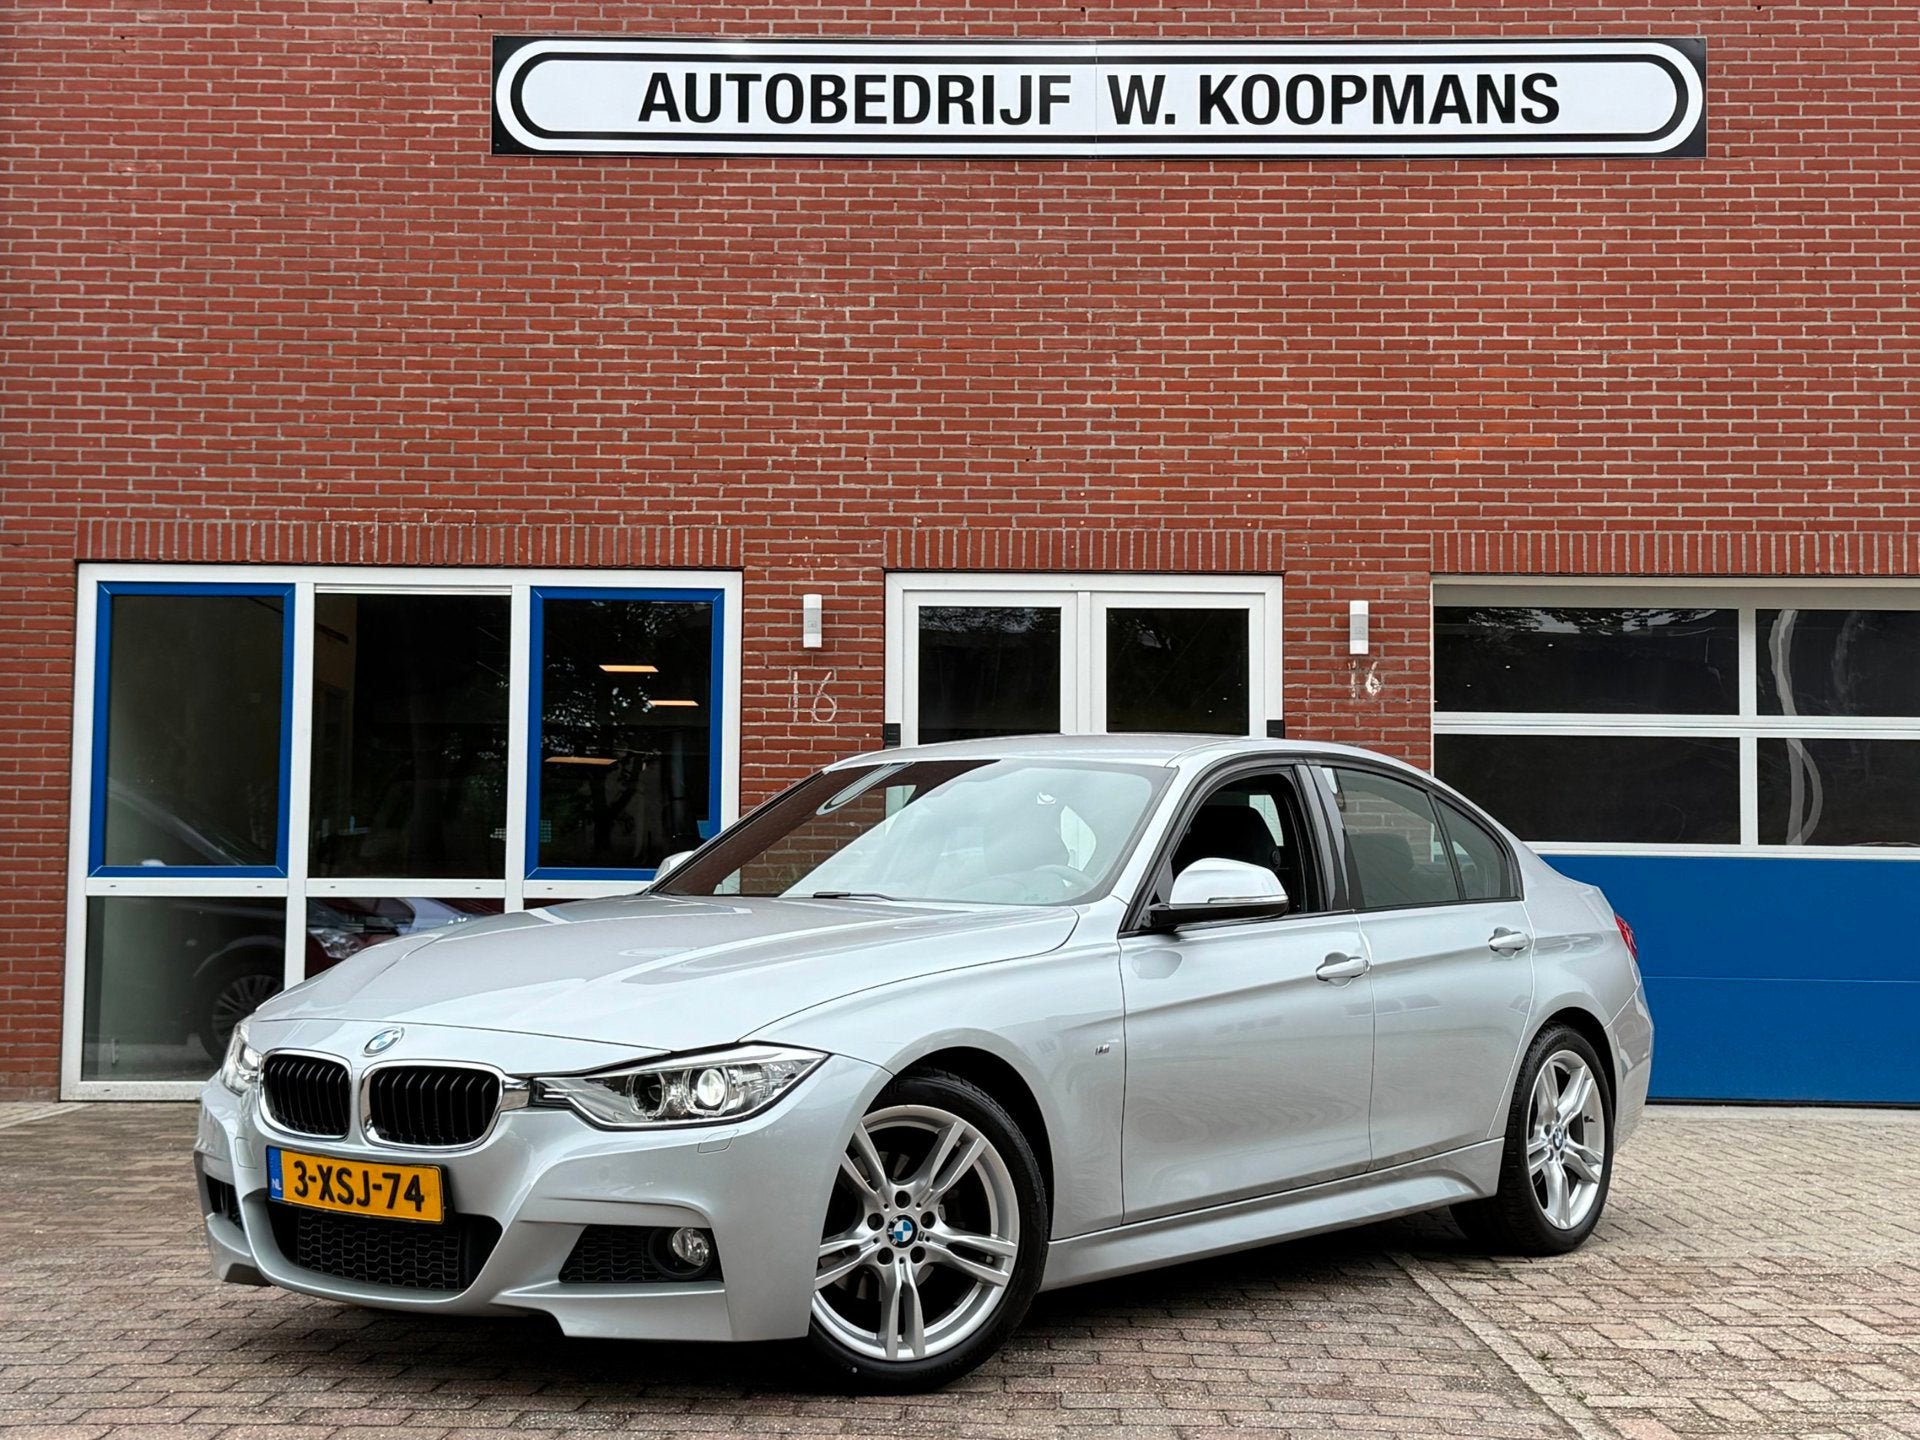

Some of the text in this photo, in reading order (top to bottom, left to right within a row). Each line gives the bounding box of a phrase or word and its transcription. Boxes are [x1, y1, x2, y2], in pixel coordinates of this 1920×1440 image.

[638, 72, 1560, 125] AUTOBEDRIJF W. KOOPMANS
[793, 671, 837, 723] 16
[1347, 660, 1382, 698] 16
[293, 1160, 425, 1212] 3-XSJ-74
